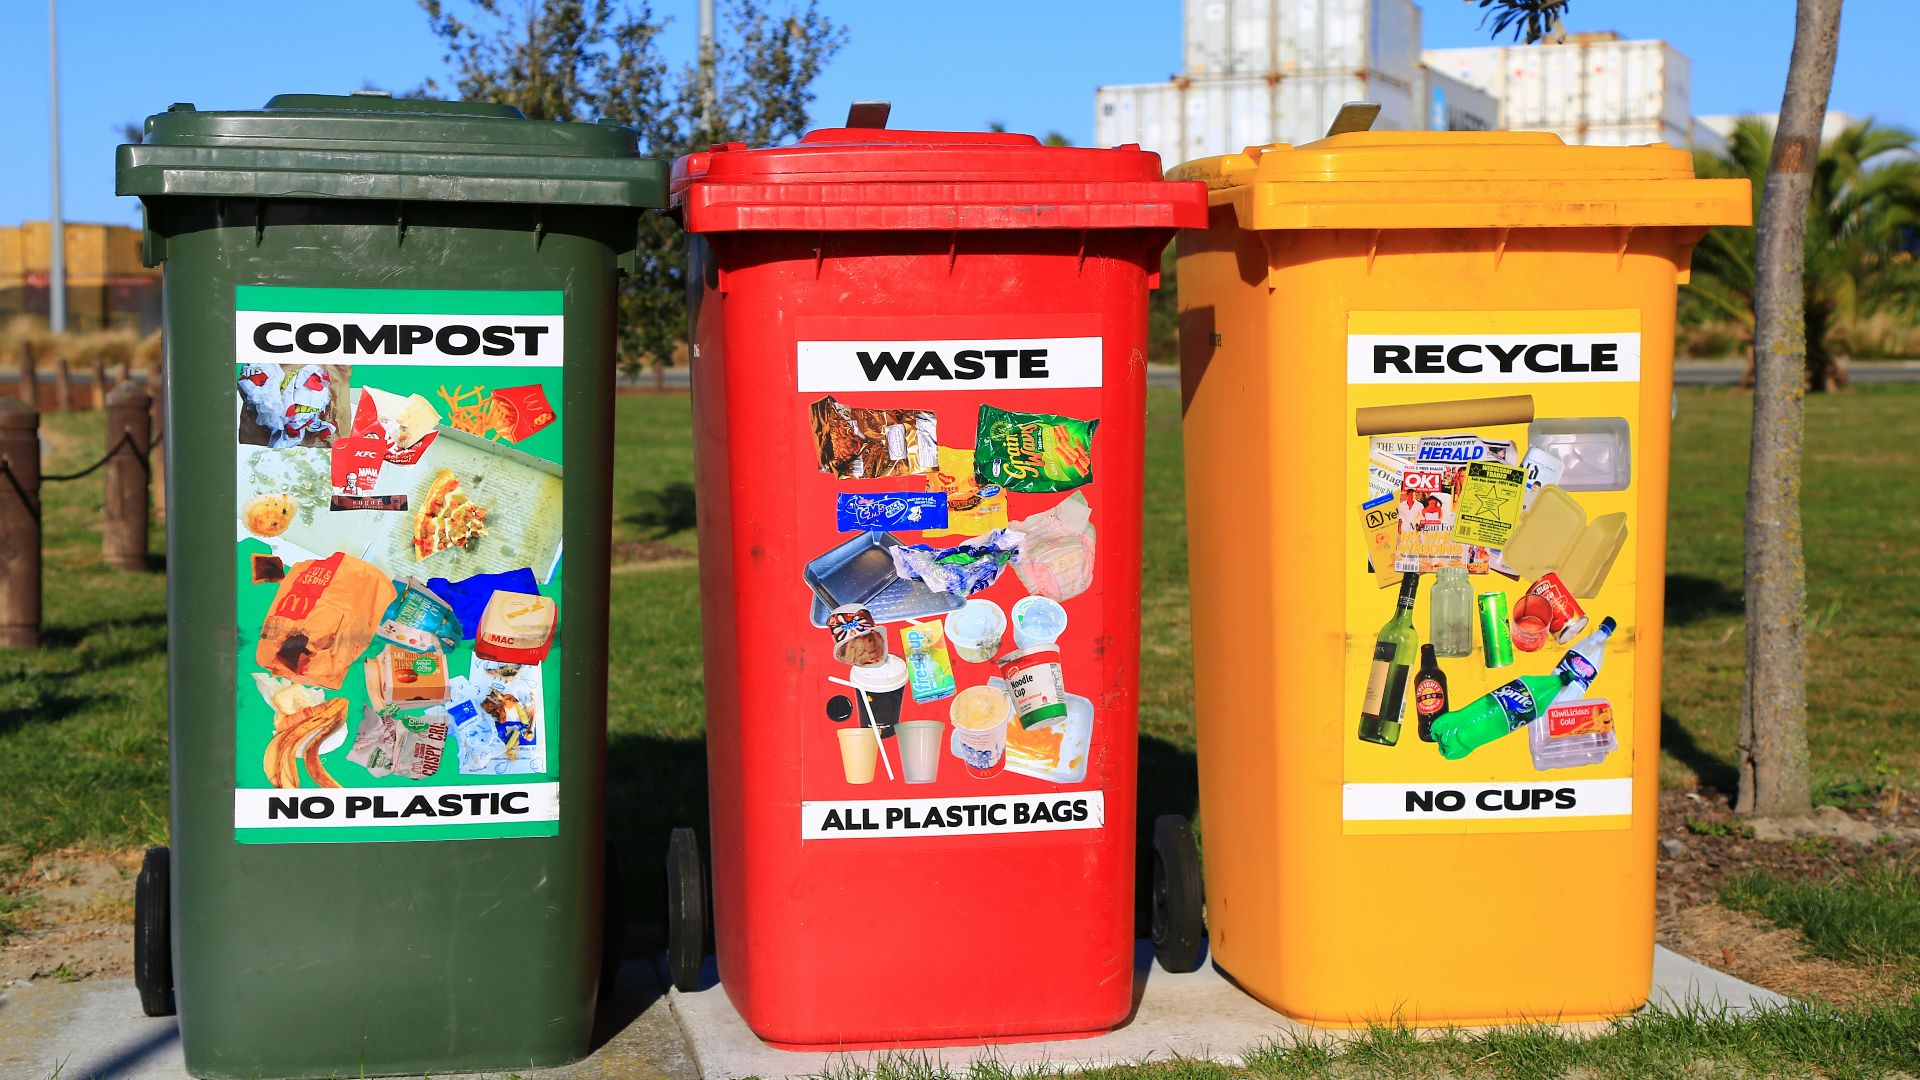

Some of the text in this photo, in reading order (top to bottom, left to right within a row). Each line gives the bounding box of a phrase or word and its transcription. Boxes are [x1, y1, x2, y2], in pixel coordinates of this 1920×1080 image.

[253, 321, 549, 357] COMPOST
[855, 349, 1049, 382] WASTE
[1373, 343, 1619, 374] RECYCLE
[354, 450, 377, 459] KFC
[1377, 441, 1395, 452] THE
[1419, 445, 1484, 460] HERALD
[1002, 433, 1040, 480] Grain
[1405, 473, 1440, 489] OK!
[1440, 523, 1454, 532] Fo
[491, 634, 514, 645] MAC
[1010, 674, 1034, 689] Noodle
[1013, 687, 1026, 698] Cup
[1493, 685, 1533, 708] Sprite
[1560, 717, 1576, 726] Gold
[421, 744, 441, 776] CRISPY
[268, 791, 530, 820] NO PLASTIC
[1405, 787, 1577, 812] NO CUPS
[821, 799, 1089, 831] ALL PLASTIC BAGS
